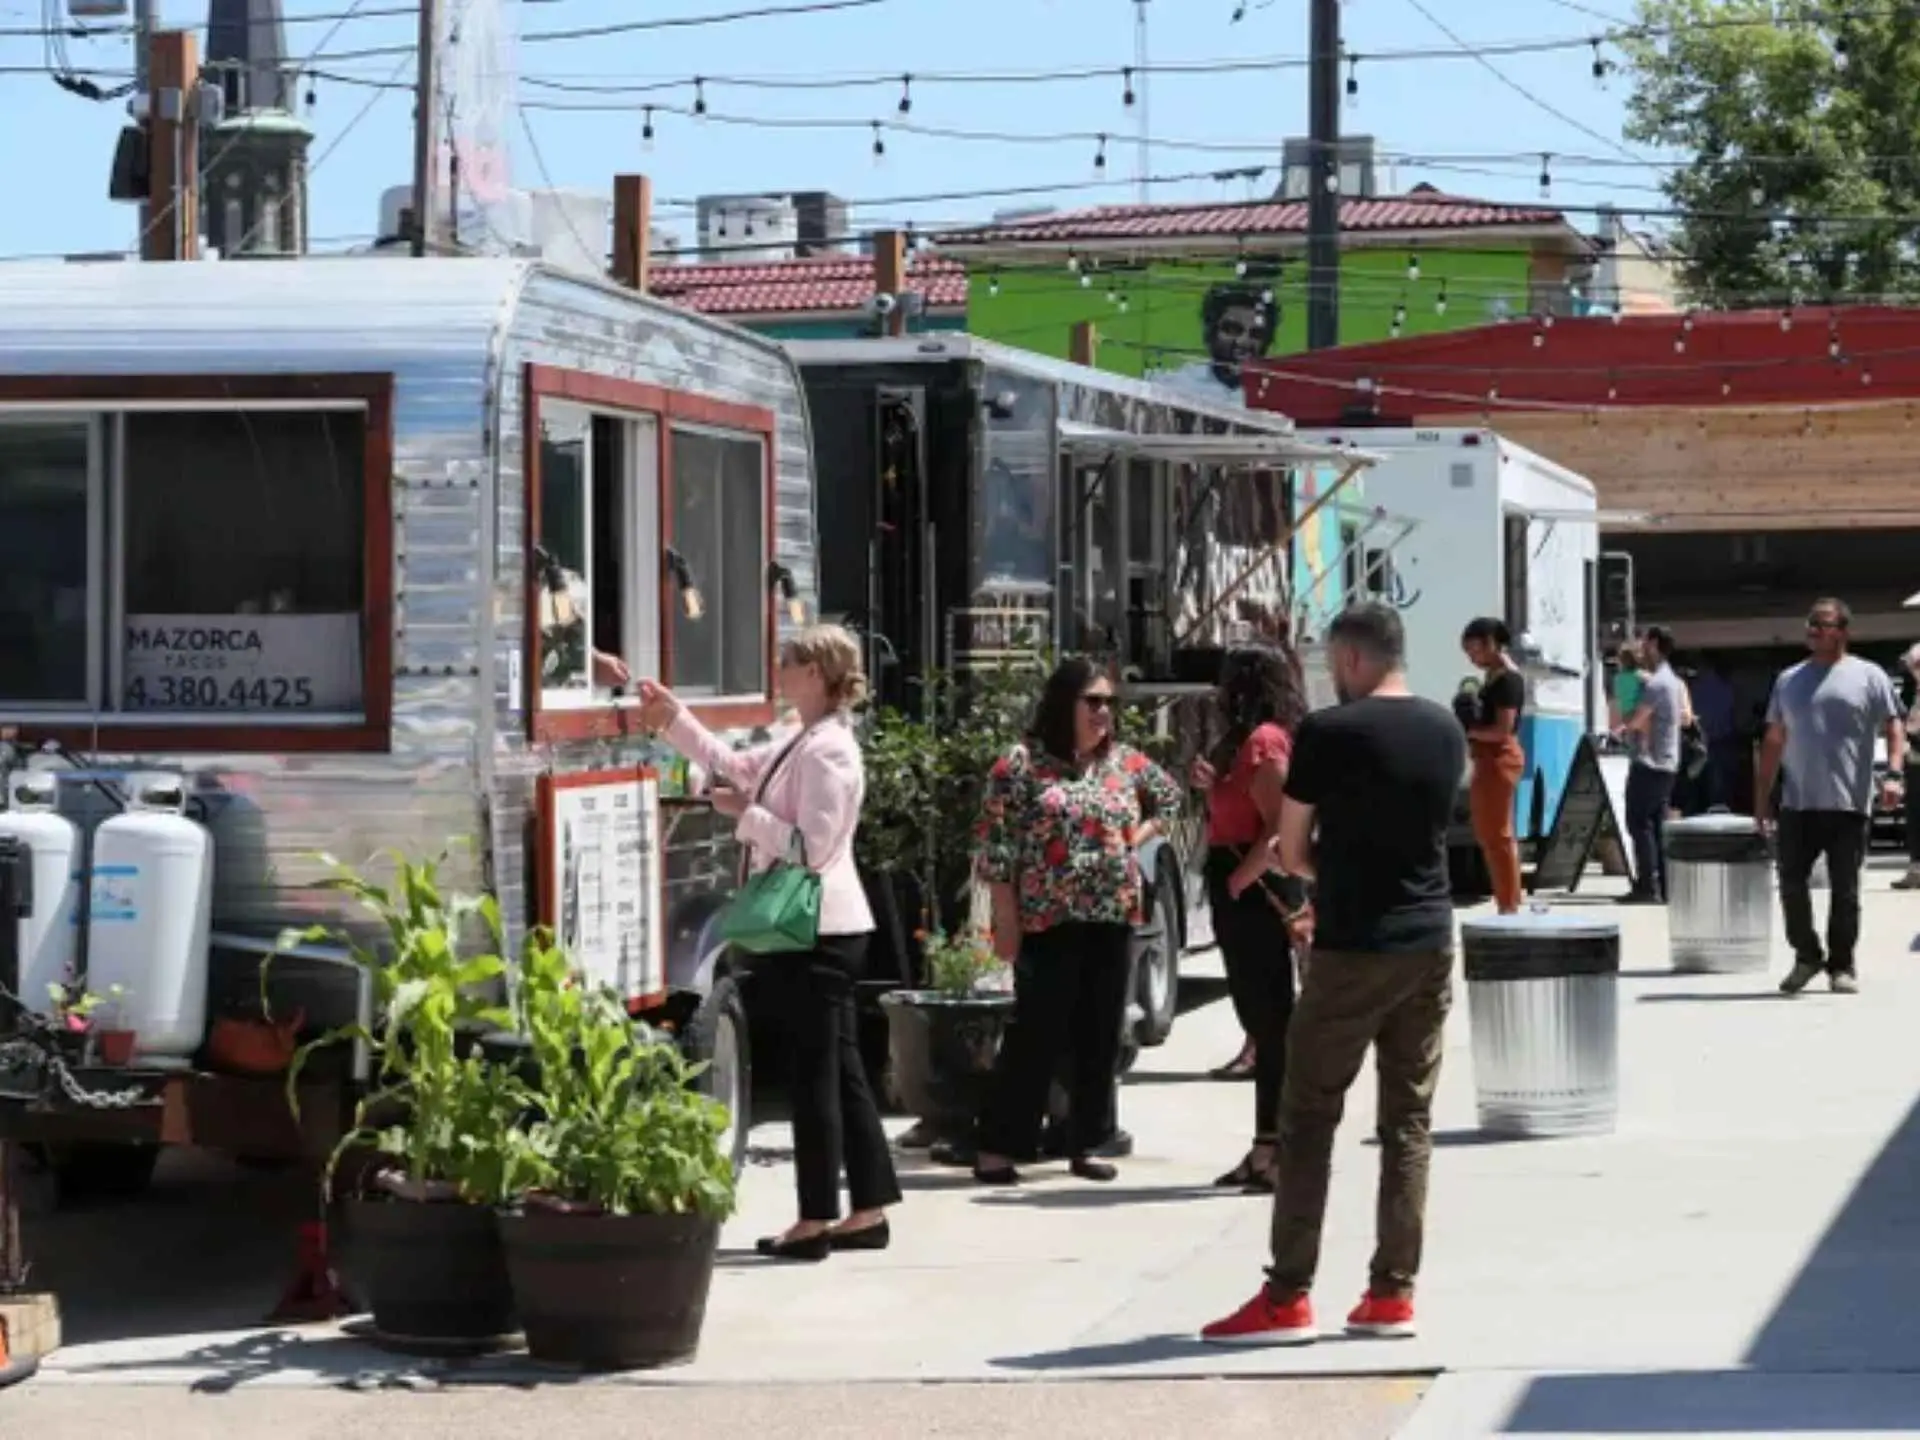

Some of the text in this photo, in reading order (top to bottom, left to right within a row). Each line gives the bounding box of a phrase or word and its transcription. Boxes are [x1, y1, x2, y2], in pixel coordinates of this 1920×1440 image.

[127, 627, 262, 650] MAZORCA
[165, 654, 228, 669] TACOS
[126, 676, 313, 706] 4.380.4425
